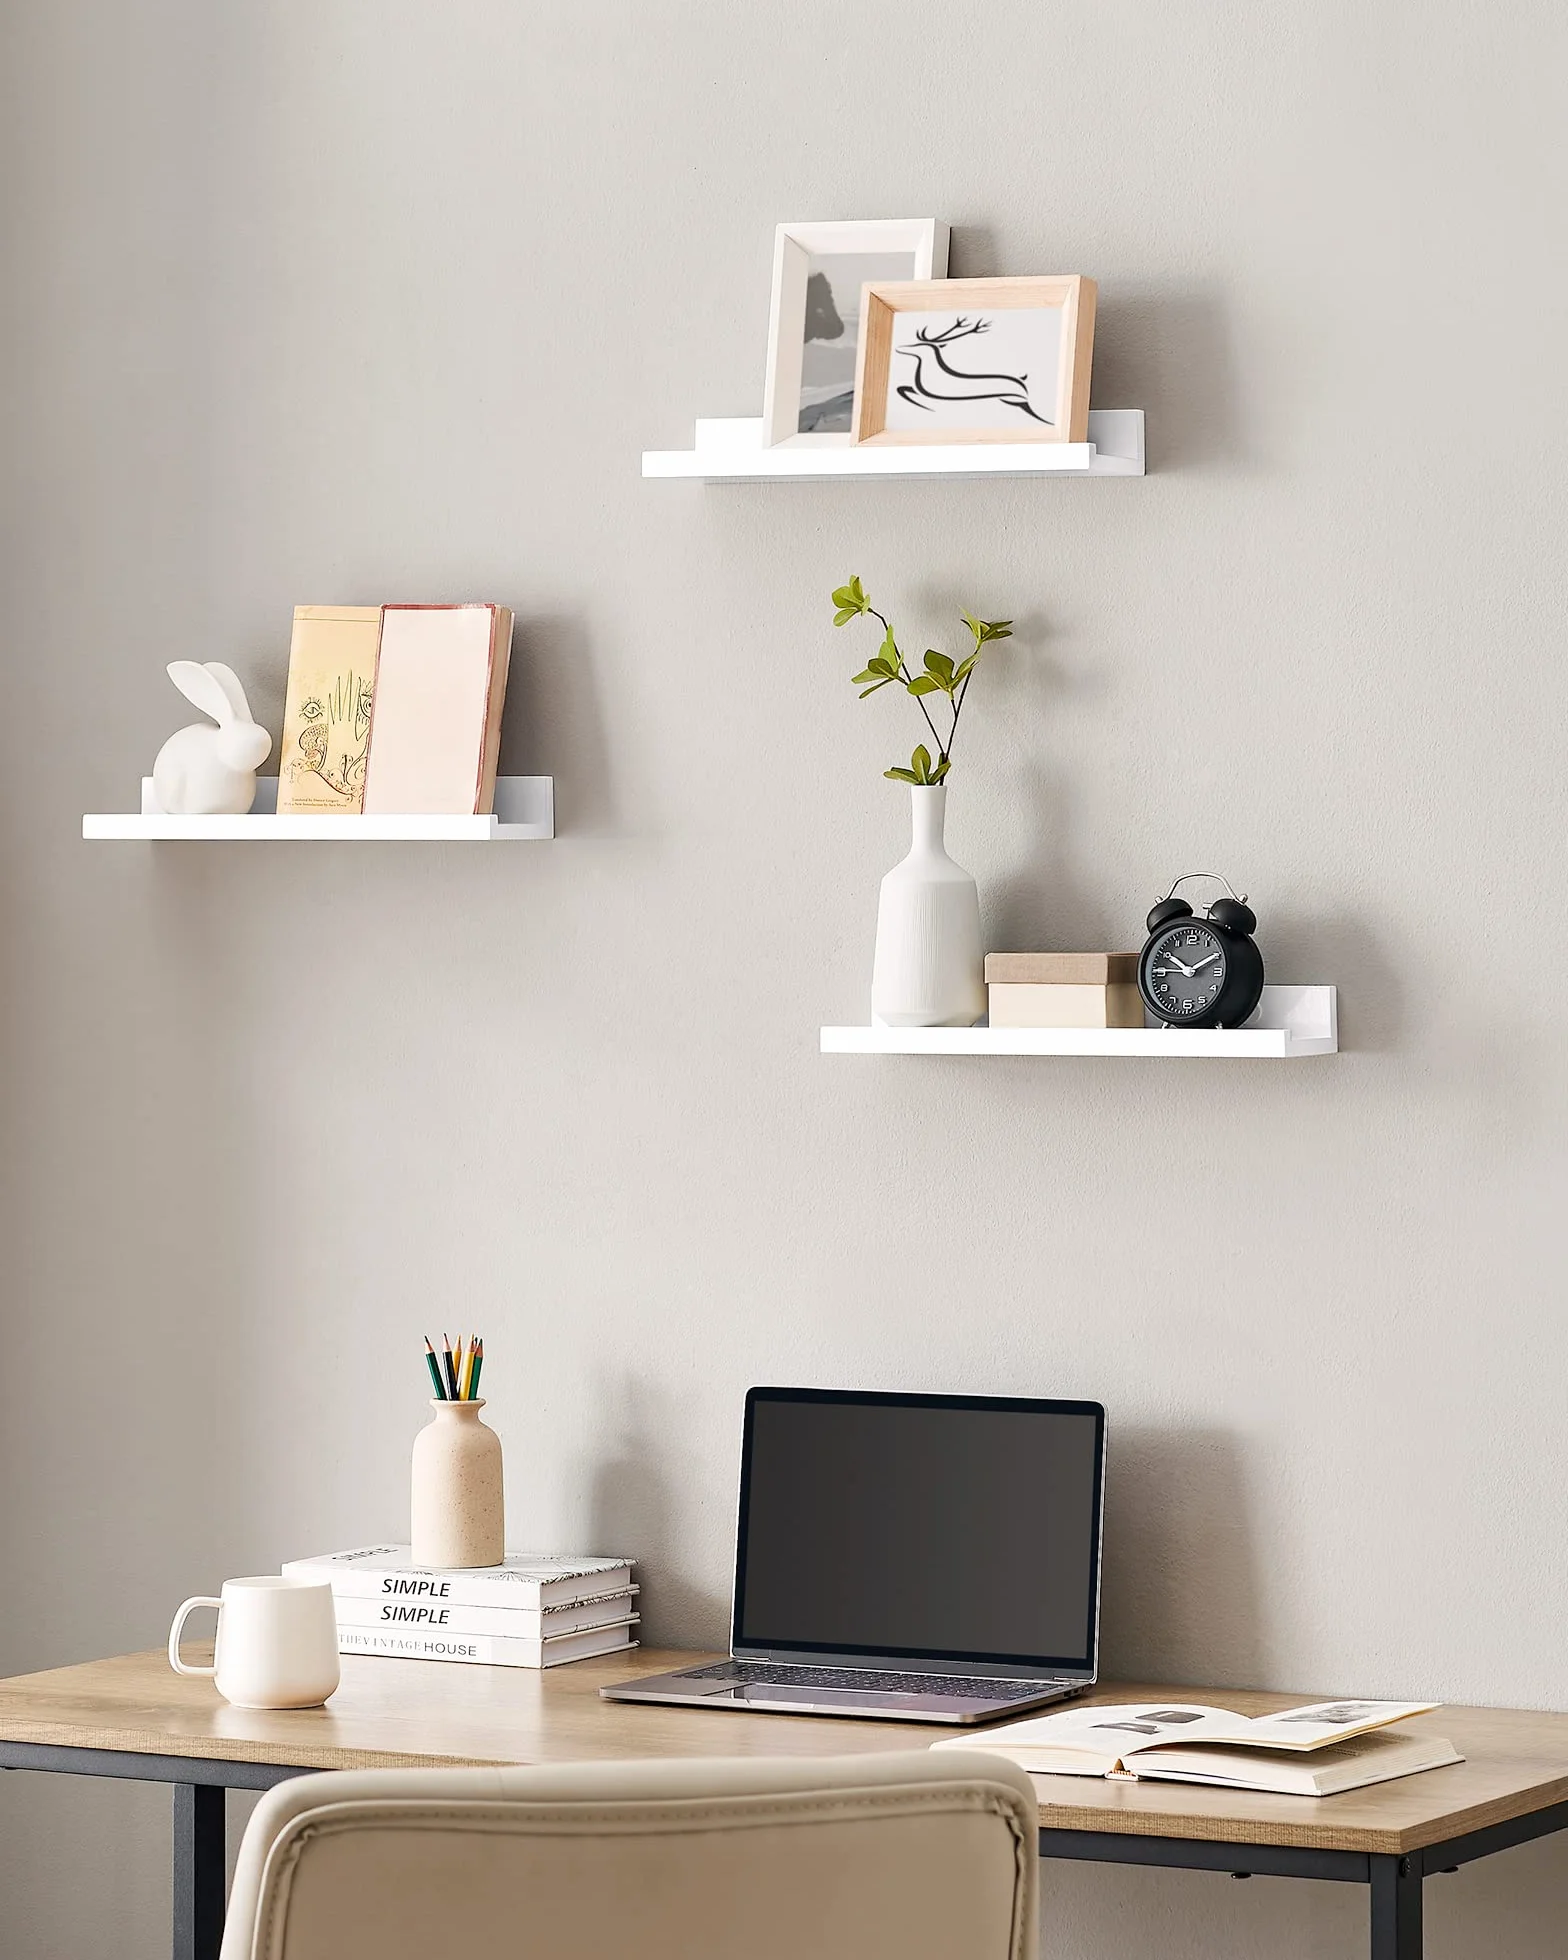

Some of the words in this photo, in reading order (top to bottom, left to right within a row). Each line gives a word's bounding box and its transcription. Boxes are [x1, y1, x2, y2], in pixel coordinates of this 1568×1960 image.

[1186, 935, 1198, 945] 12
[1213, 967, 1223, 977] 3
[1160, 984, 1168, 992] 8
[1209, 984, 1217, 992] 4
[1169, 996, 1176, 1004] 7
[1182, 999, 1193, 1010] 6
[1198, 996, 1206, 1004] 5
[381, 1578, 451, 1597] SIMPLE
[380, 1605, 451, 1624] SIMPLE
[424, 1642, 477, 1656] HOUSE
